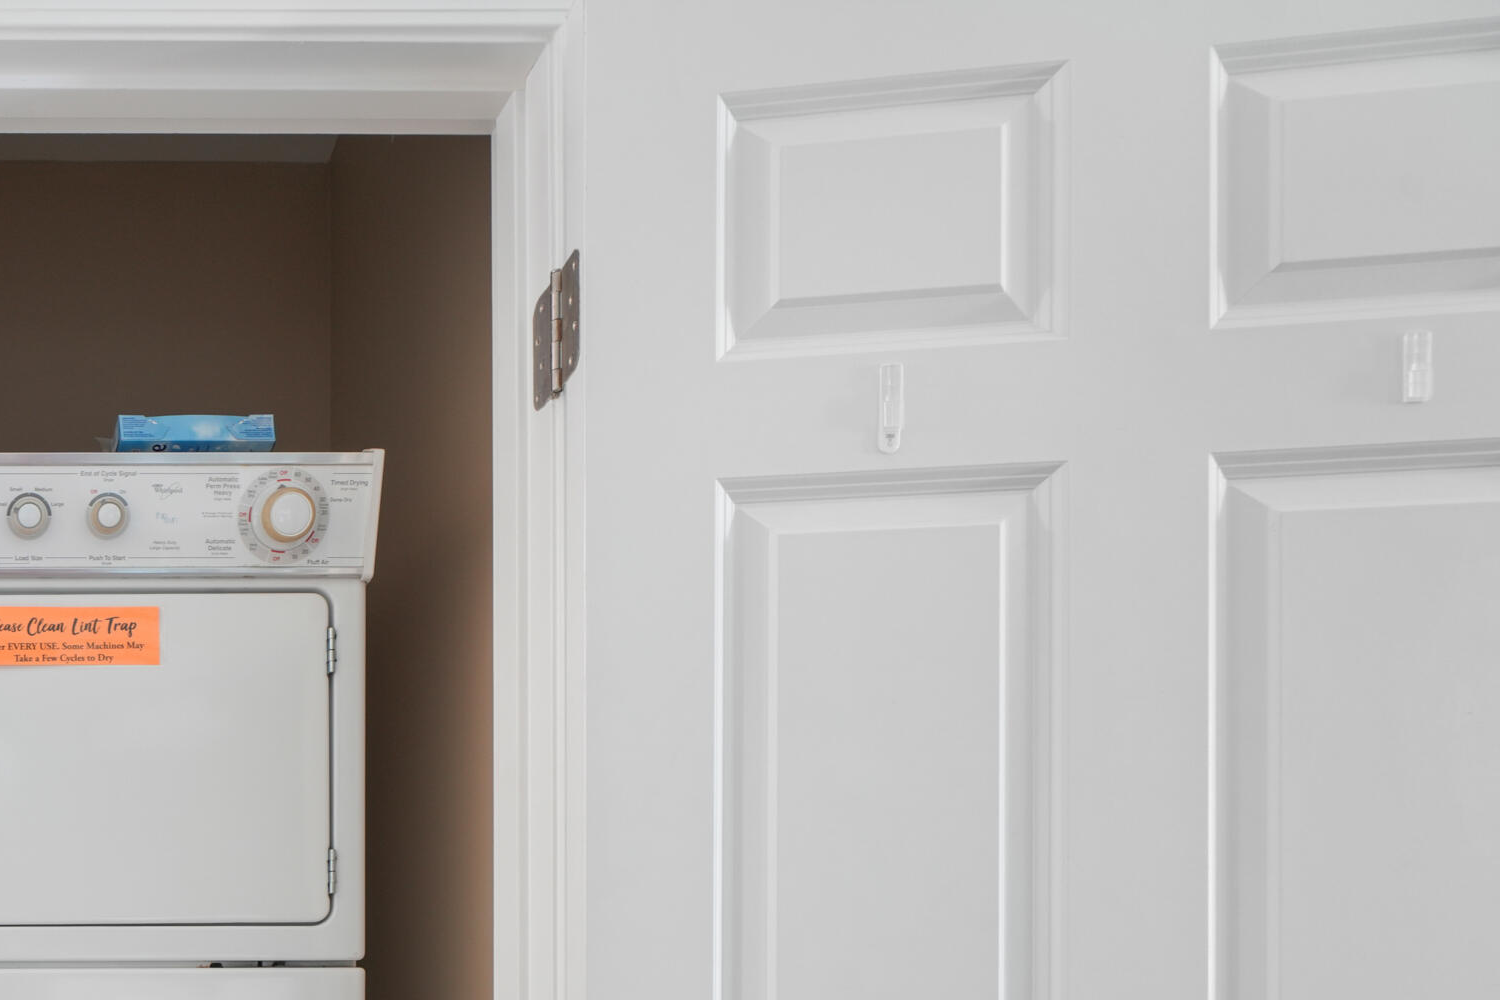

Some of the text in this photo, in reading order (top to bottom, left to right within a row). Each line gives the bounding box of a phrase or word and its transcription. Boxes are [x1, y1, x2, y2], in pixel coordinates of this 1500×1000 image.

[27, 617, 65, 636] Clean
[71, 617, 100, 636] Lint
[104, 616, 137, 638] Trap
[7, 642, 38, 651] EVERY
[39, 642, 60, 651] USE.
[62, 642, 84, 650] Some
[86, 641, 125, 650] Machines
[127, 641, 145, 651] May
[14, 654, 33, 662] Take
[42, 654, 57, 662] Few
[60, 654, 85, 664] Cycles
[98, 654, 114, 664] Dry
